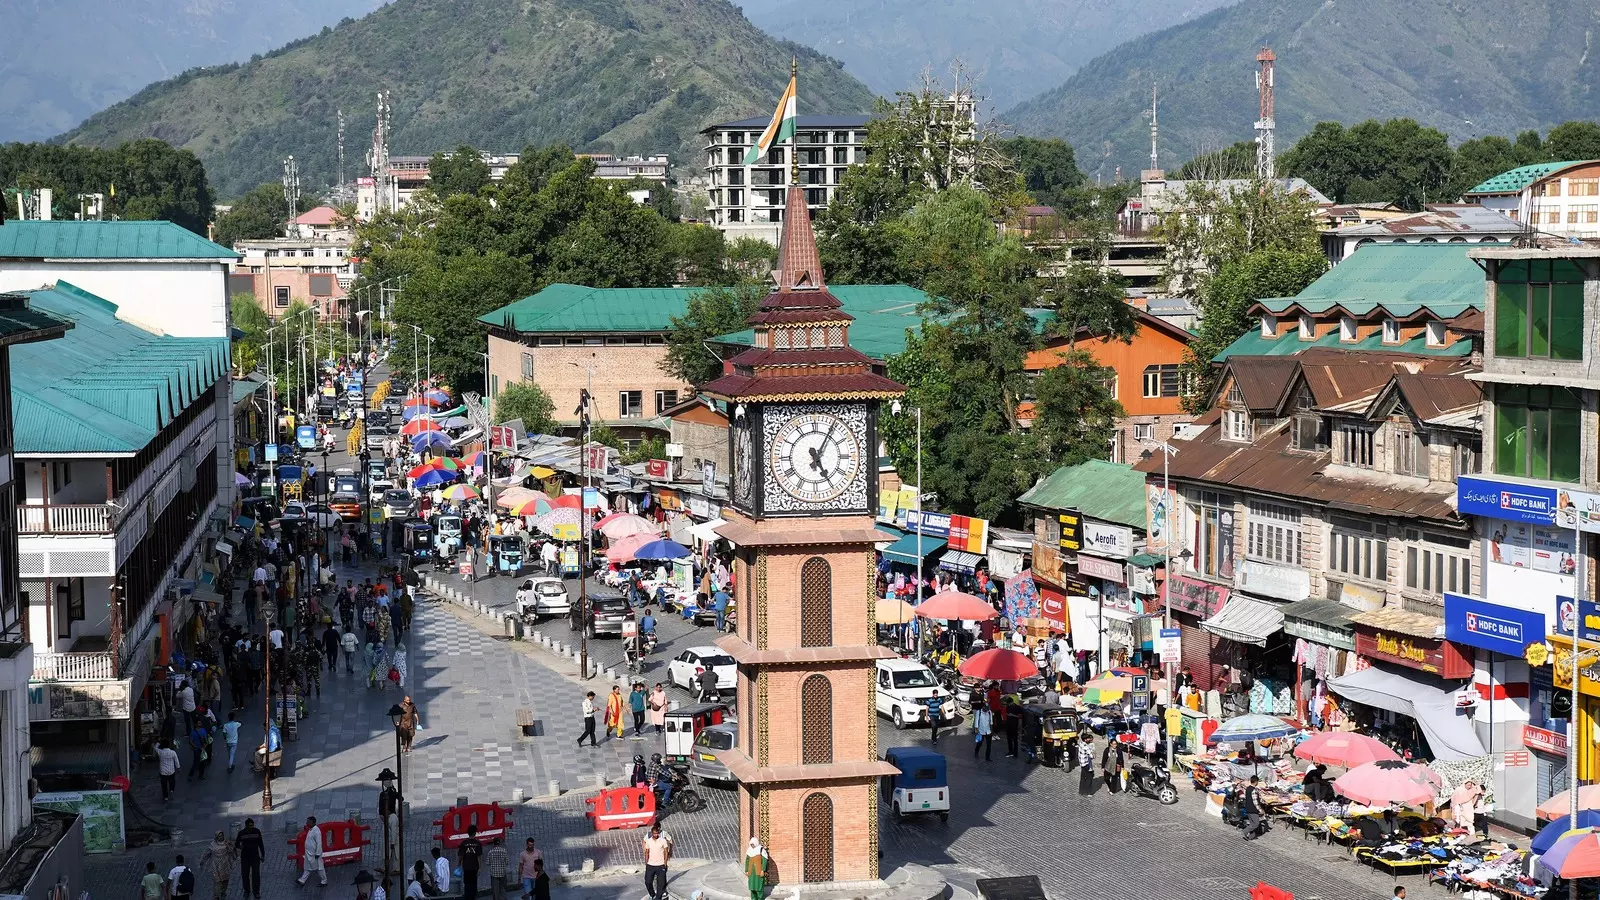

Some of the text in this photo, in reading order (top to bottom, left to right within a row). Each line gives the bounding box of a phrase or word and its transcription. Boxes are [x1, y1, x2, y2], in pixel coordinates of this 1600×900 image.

[1511, 497, 1547, 510] HDFC BANK
[925, 514, 951, 529] LUGGAGE
[1095, 532, 1117, 546] Aerofit
[1081, 559, 1119, 578] ZEE SPORTS
[1296, 617, 1324, 635] REGAL
[1478, 620, 1519, 637] HDFC BANK
[1137, 678, 1144, 687] P
[1525, 730, 1548, 742] ALLIED
